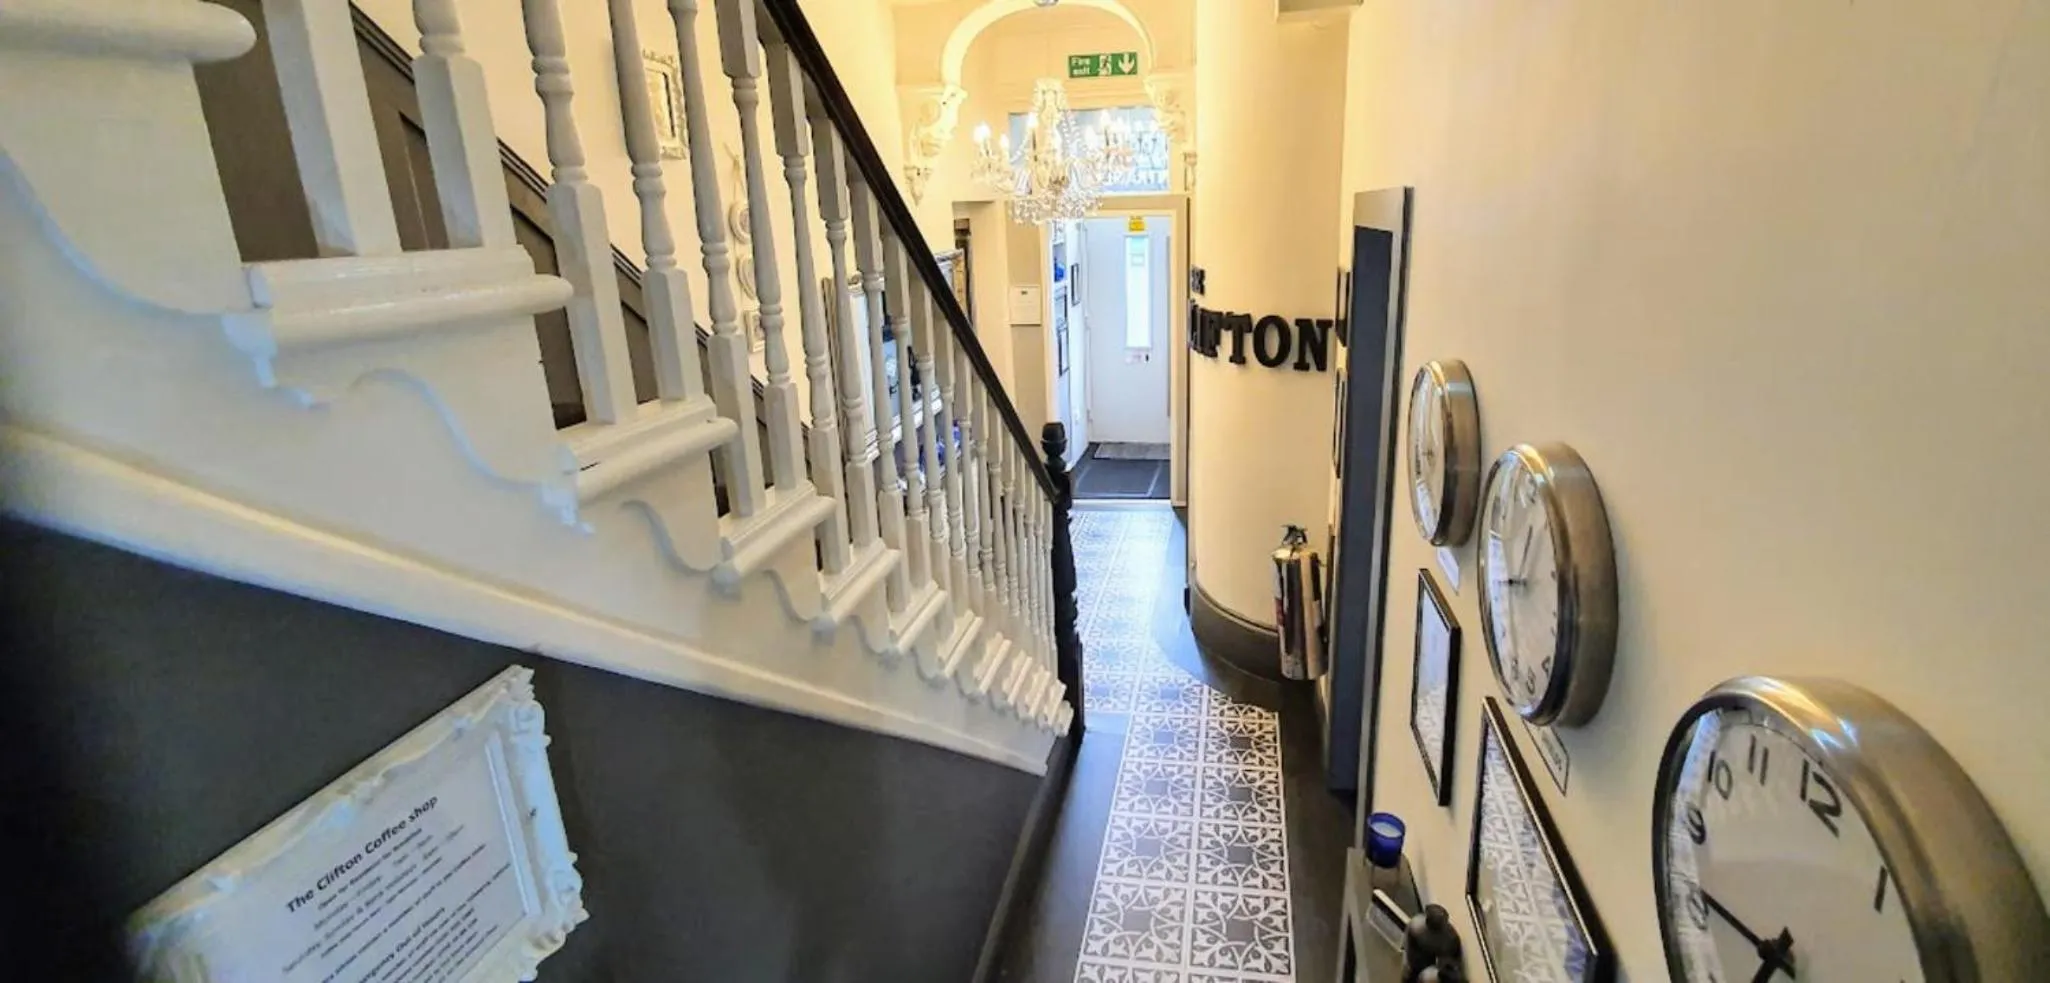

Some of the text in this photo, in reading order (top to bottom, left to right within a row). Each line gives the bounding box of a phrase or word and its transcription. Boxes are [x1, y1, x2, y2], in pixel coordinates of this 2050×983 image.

[1708, 750, 1733, 800] 10
[1748, 735, 1769, 785] 11
[1800, 759, 1843, 838] 12
[1686, 805, 1706, 845] 9
[287, 889, 314, 914] The
[315, 852, 363, 892] Clifton
[364, 819, 407, 855] Coffee
[407, 796, 438, 823] shop
